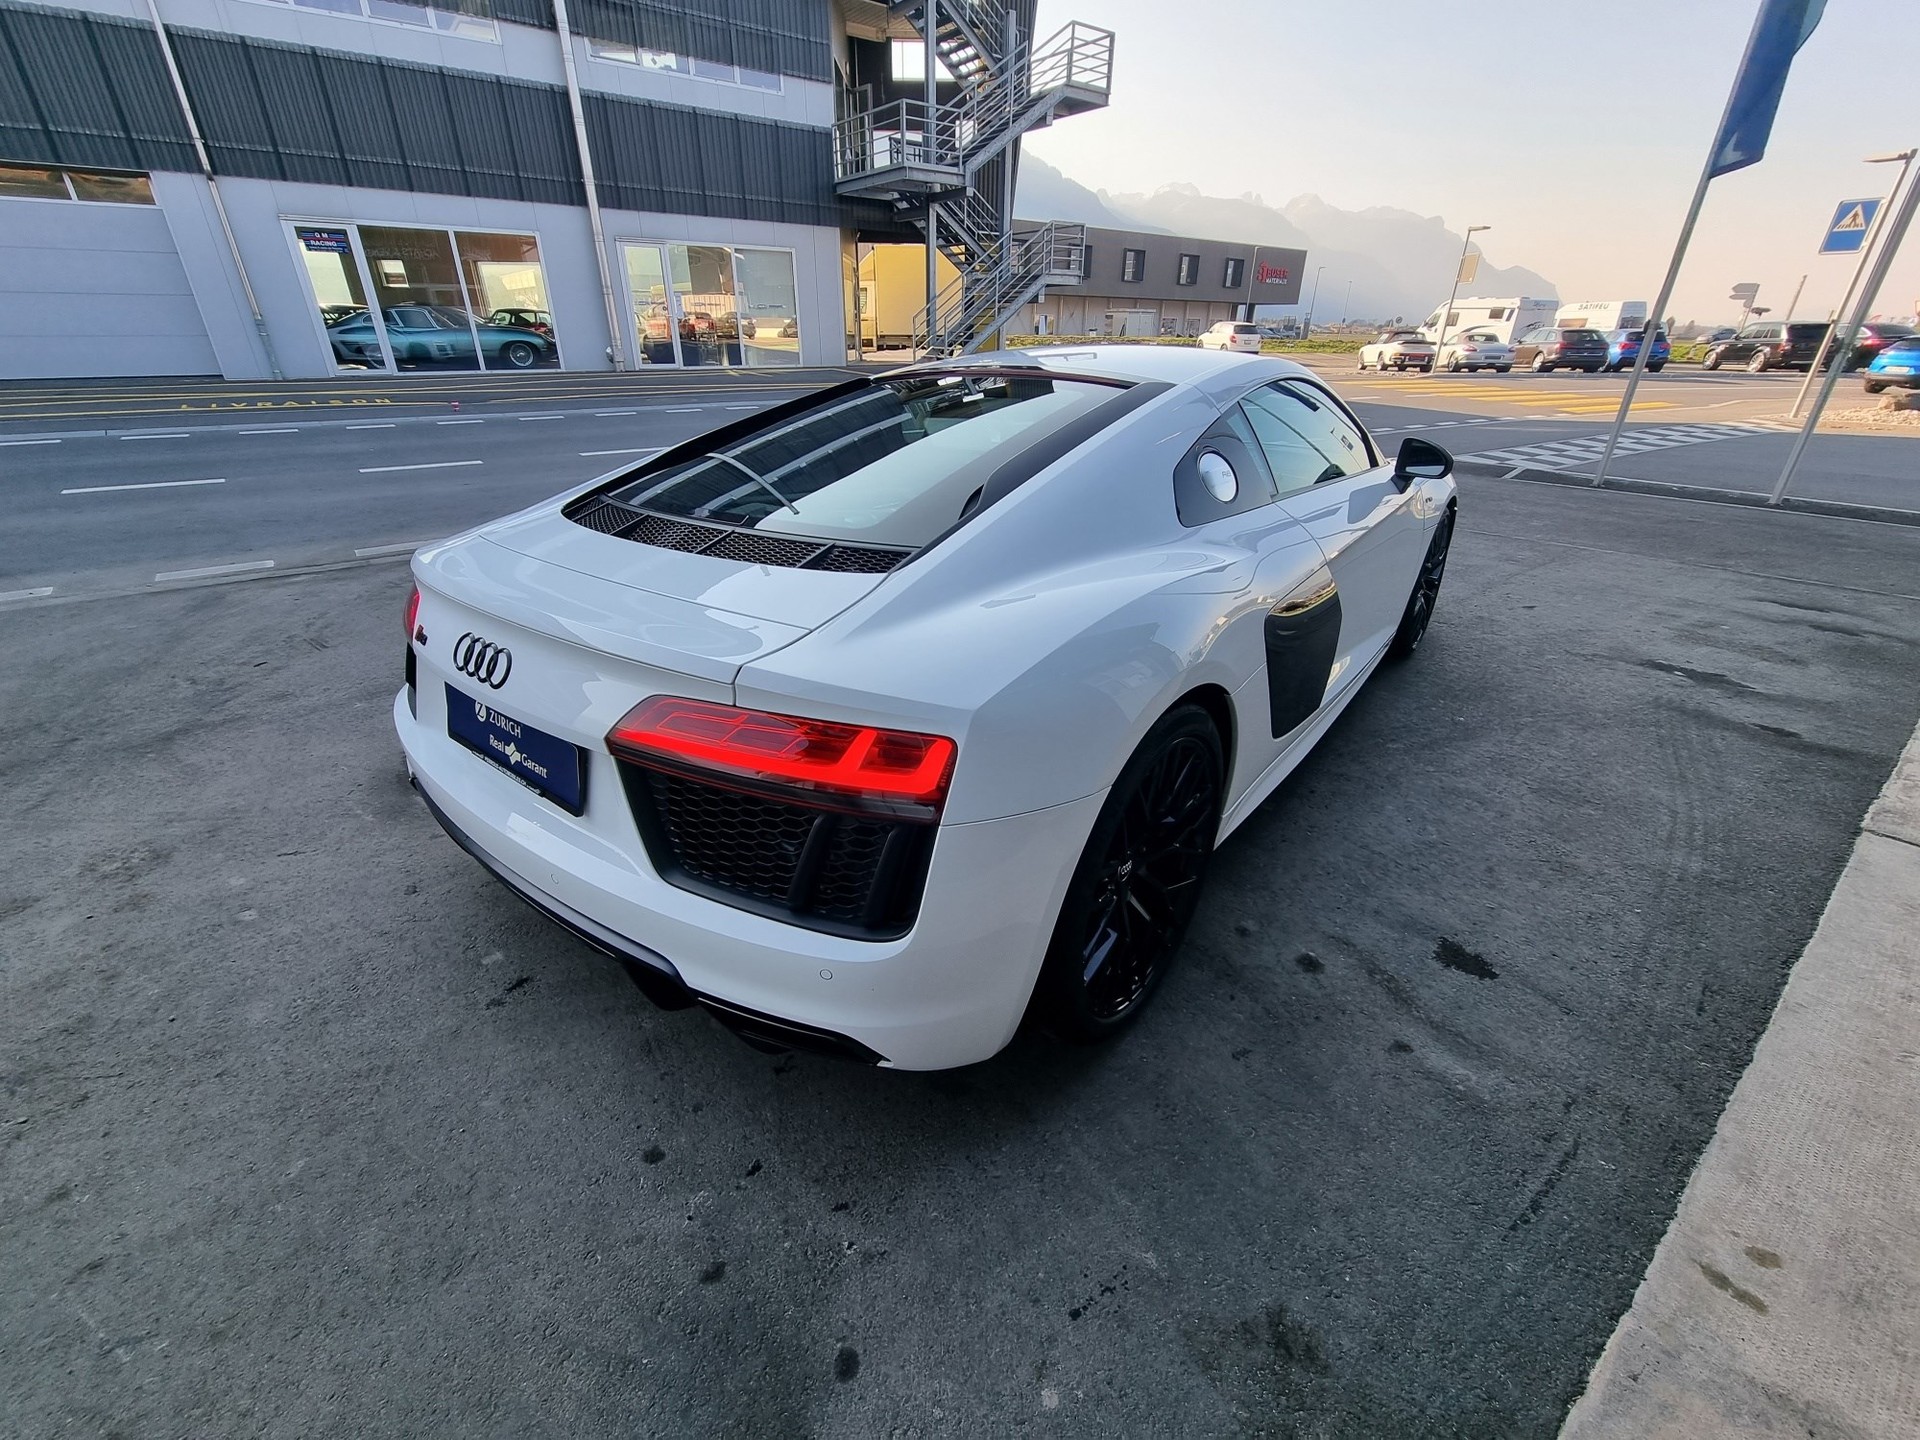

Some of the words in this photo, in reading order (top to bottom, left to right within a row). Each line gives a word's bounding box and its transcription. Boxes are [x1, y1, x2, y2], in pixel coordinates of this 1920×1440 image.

[180, 398, 391, 410] LIVRAISON
[489, 709, 521, 739] ZURICH
[489, 733, 504, 753] Real
[521, 753, 548, 779] Garant
